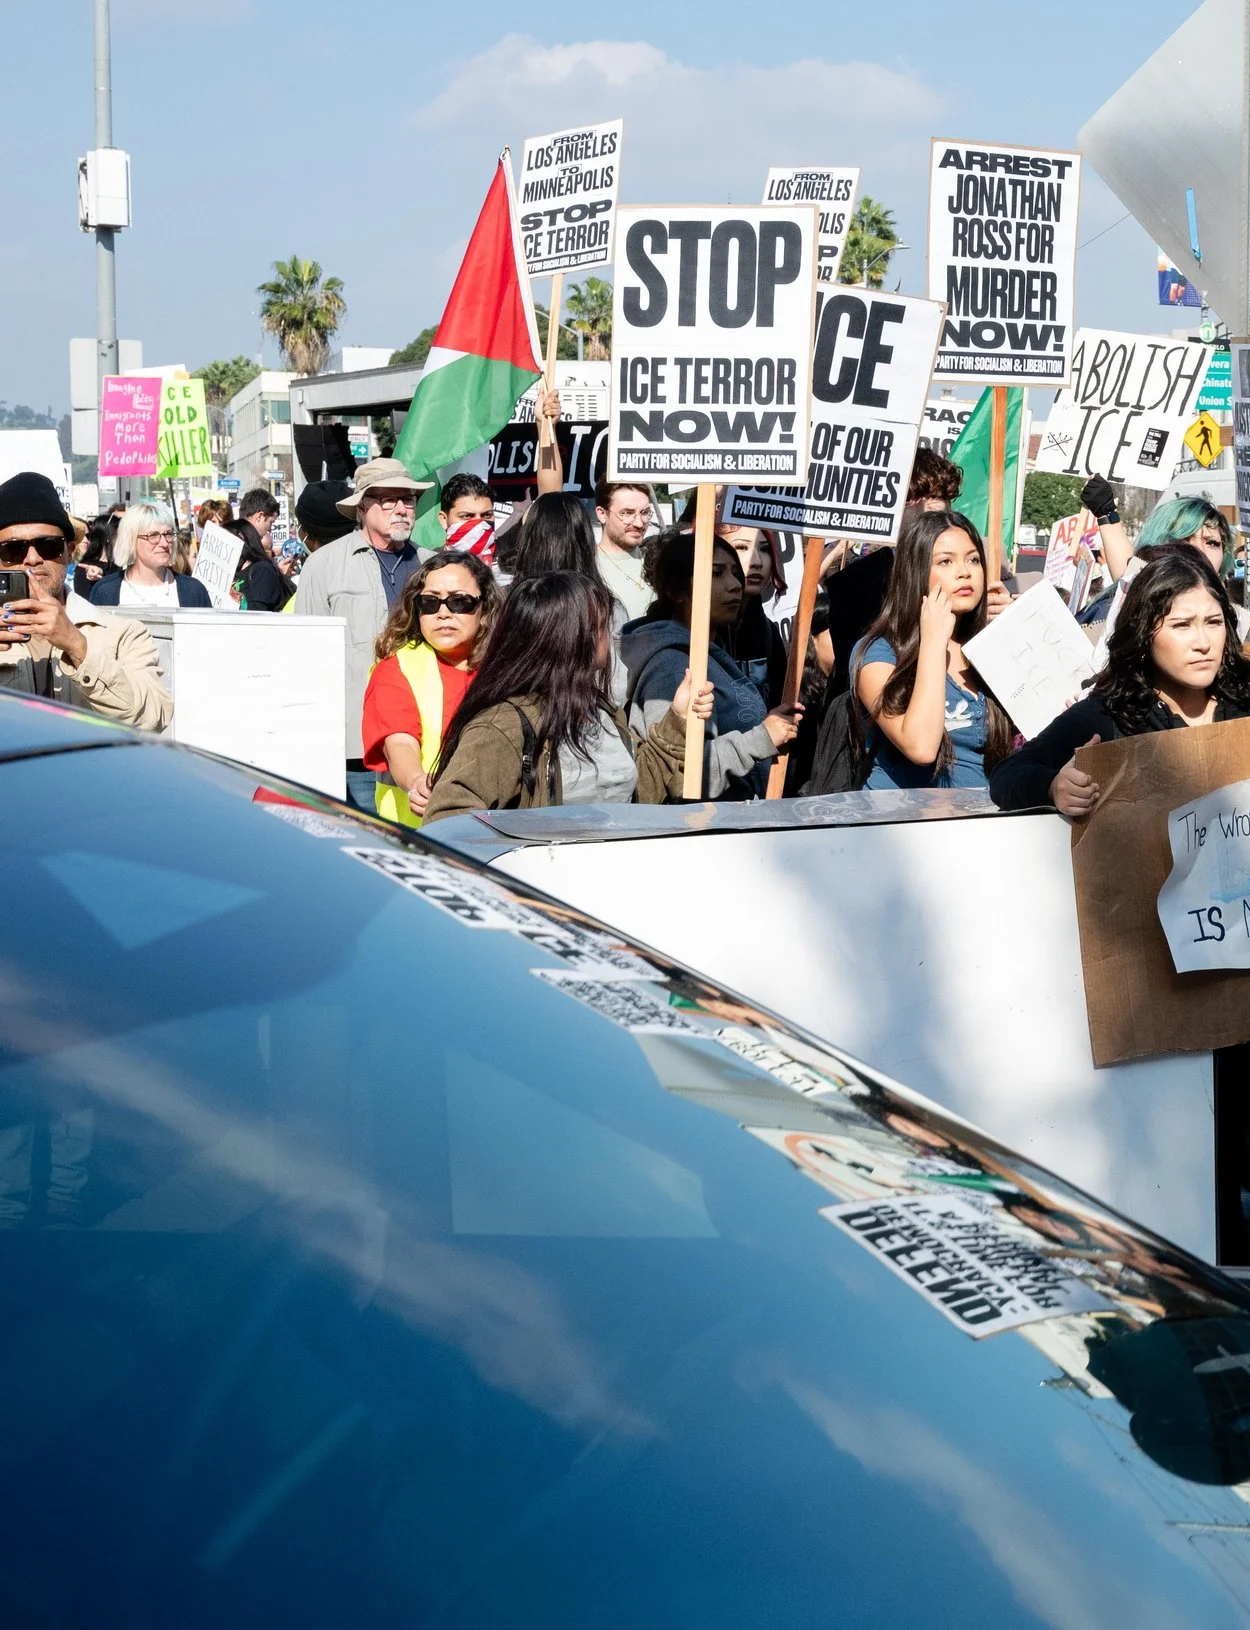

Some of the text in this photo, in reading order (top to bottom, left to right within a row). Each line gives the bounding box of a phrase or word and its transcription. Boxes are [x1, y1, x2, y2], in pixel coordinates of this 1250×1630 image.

[527, 131, 618, 171] LOS ANGELES
[553, 131, 594, 147] FROM
[560, 166, 580, 176] TO
[794, 173, 831, 182] FROM
[939, 148, 1072, 180] ARREST
[523, 165, 614, 204] MINNEAPOLIS
[767, 178, 853, 201] LOS ANGELES
[947, 173, 1062, 223] JONATHAN
[520, 199, 612, 232] STOP
[524, 220, 610, 259] CE TERROR
[952, 216, 1055, 264] ROSS FOR
[622, 219, 802, 329] STOP
[946, 264, 1058, 321] MURDER
[812, 291, 906, 408] CE
[939, 319, 1066, 352] NOW!
[619, 356, 796, 405] ICE TERROR
[935, 354, 1063, 374] PARTY FOR SOCIALISM & LIBERATION
[1054, 339, 1207, 416] ABOLISH
[1210, 360, 1229, 369] vera
[108, 381, 142, 396] Imagine
[167, 386, 192, 401] CE
[1199, 395, 1224, 406] Union
[115, 422, 145, 433] More
[164, 406, 197, 425] OLD
[618, 410, 796, 443] NOW!
[947, 426, 961, 435] IS
[114, 433, 145, 445] Than
[811, 422, 846, 461] OF
[844, 426, 895, 468] OUR
[1062, 405, 1143, 483] ICE
[562, 425, 609, 492] IC
[619, 453, 794, 471] PARTY FOR SOCIALISM & LIBERATION
[734, 500, 891, 532] PARTY FOR SOCIALISM & LIBERATION
[203, 533, 235, 564] ARREST
[1178, 811, 1207, 854] The
[1188, 906, 1226, 943] IS
